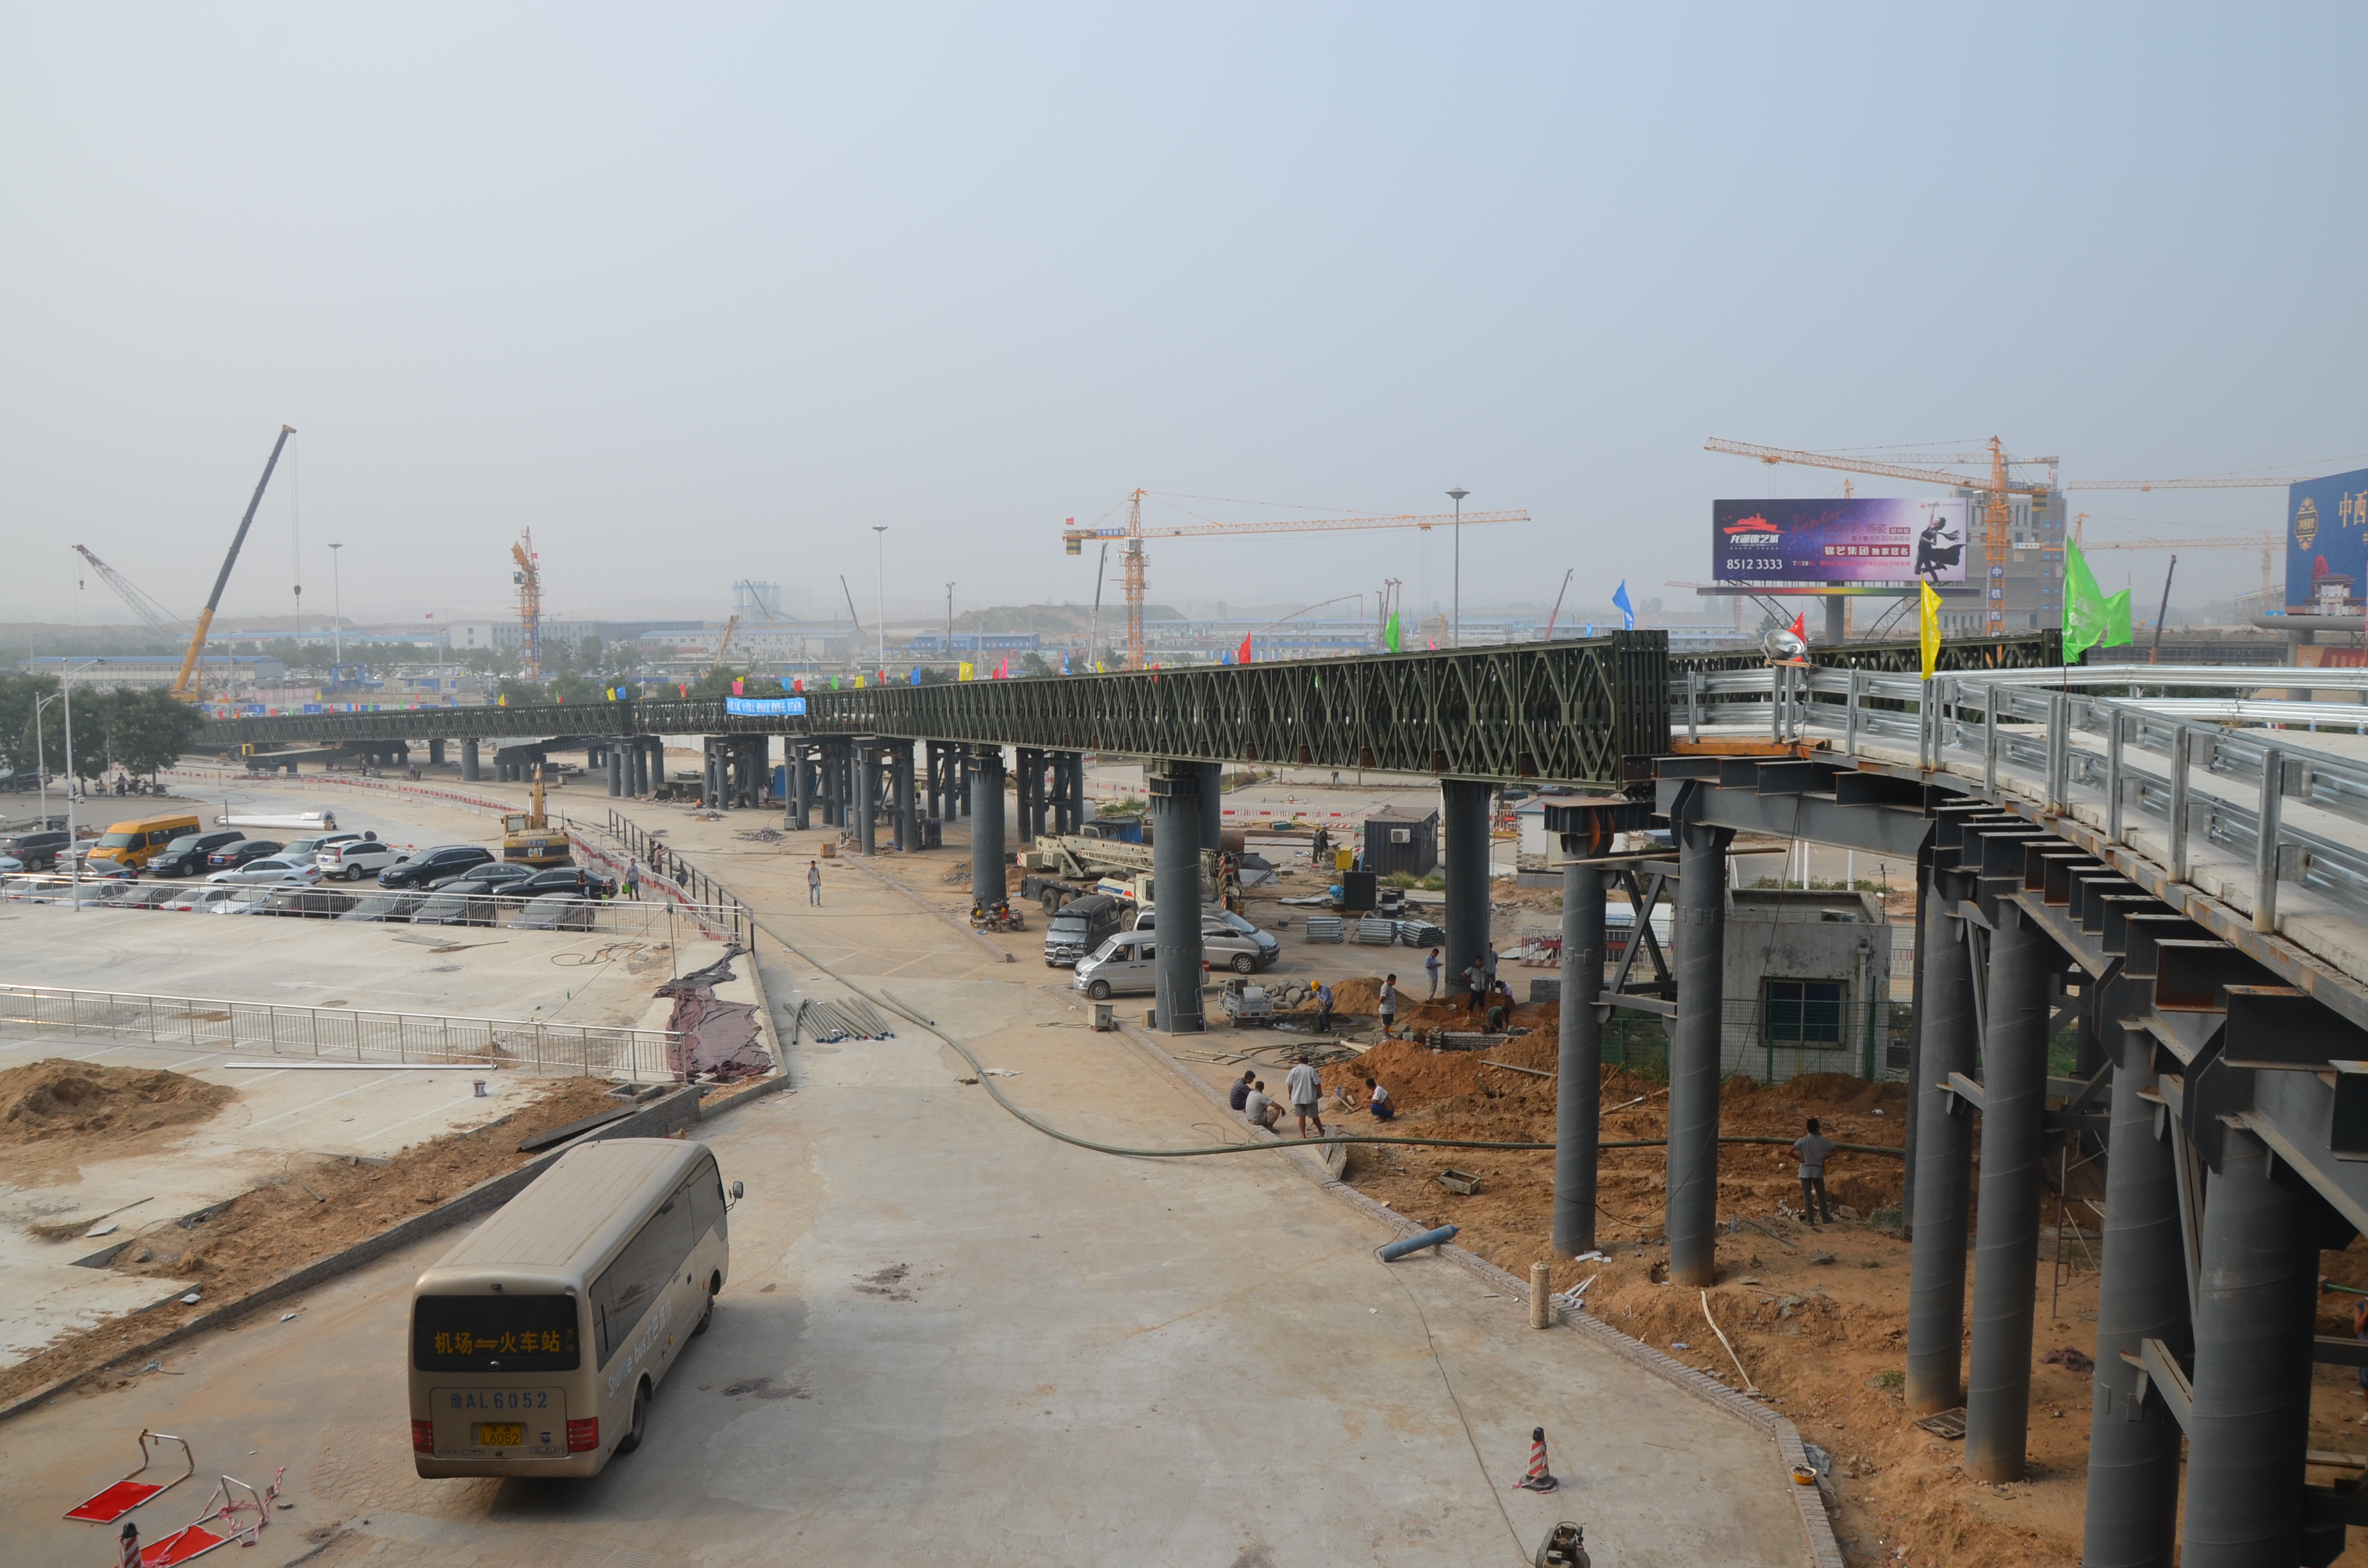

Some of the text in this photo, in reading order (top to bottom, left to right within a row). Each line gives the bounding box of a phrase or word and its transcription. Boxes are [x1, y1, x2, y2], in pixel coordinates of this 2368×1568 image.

[1825, 546, 1908, 555] 锦艺集团 独家冠名
[1727, 559, 1782, 569] 8512 3333
[528, 847, 543, 857] CAT
[434, 1330, 560, 1354] 机场 火车站
[634, 1337, 646, 1364] bus
[450, 1392, 547, 1409] 豫AL6052
[482, 1433, 519, 1445] L6052
